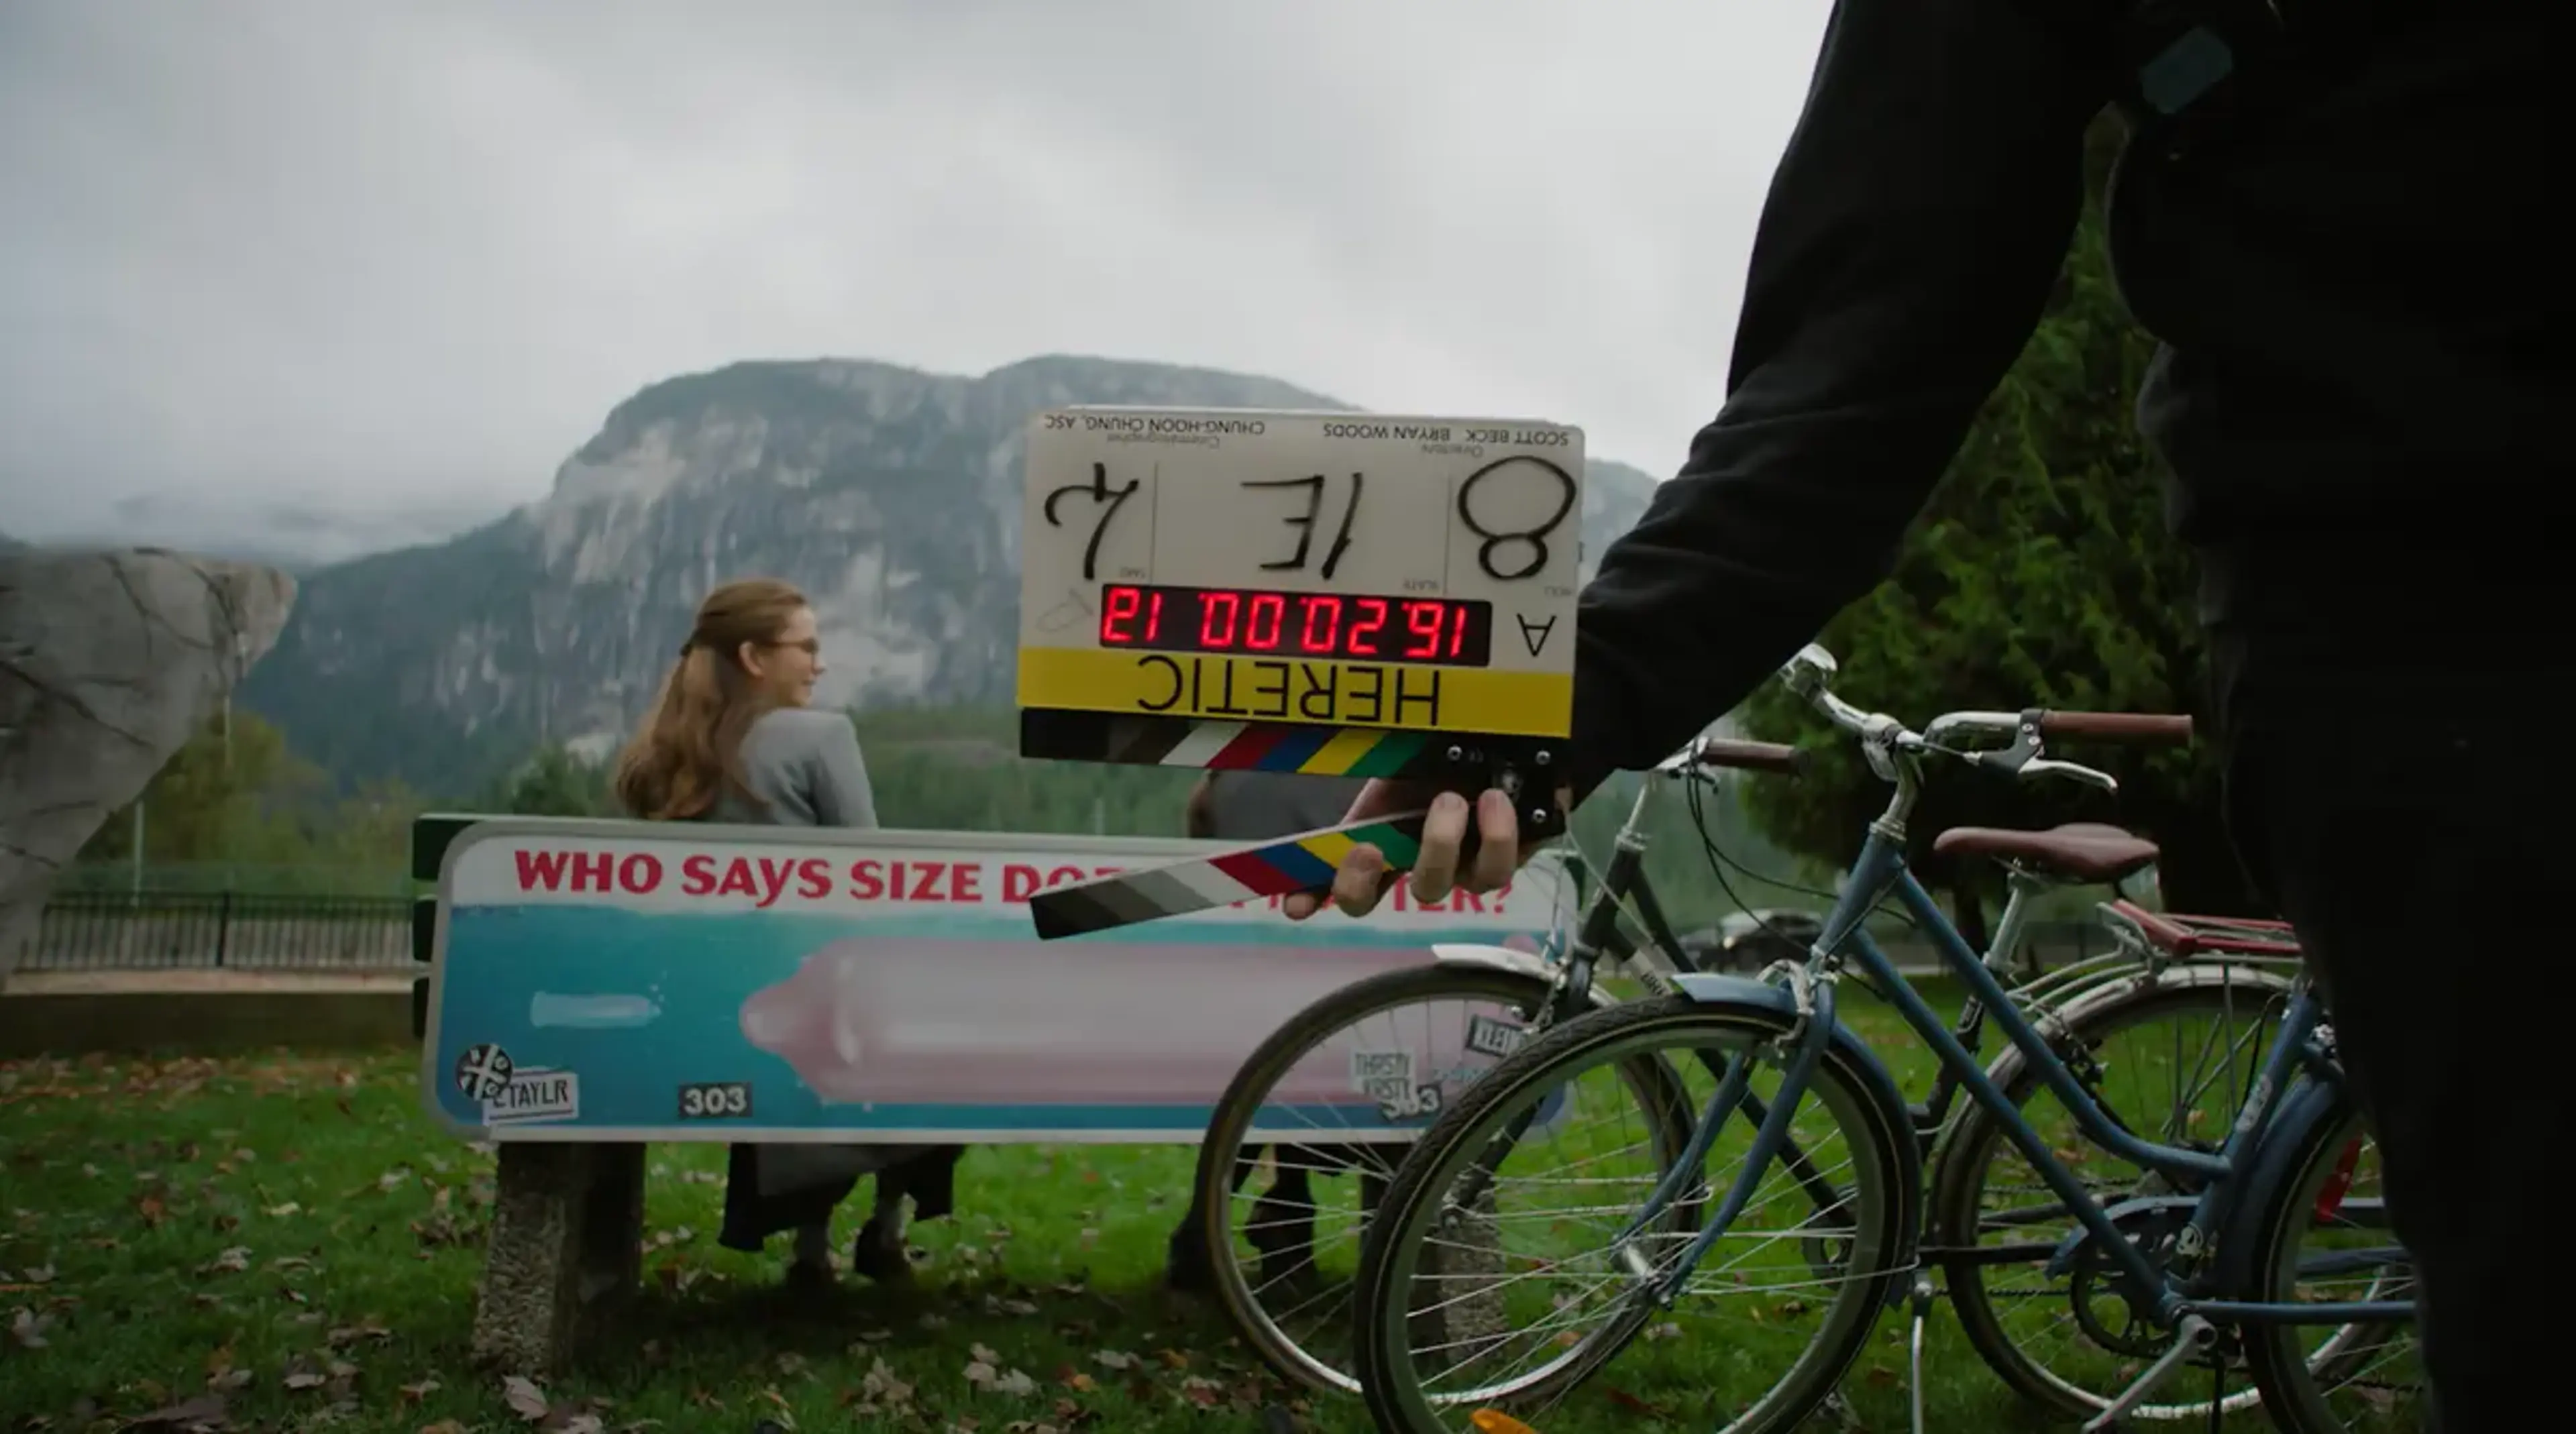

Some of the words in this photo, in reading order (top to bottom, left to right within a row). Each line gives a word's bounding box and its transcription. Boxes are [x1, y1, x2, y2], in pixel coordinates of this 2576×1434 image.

[1044, 414, 1075, 430] ASC
[1149, 418, 1266, 435] CHUNG-HOON
[1323, 423, 1389, 440] WOODS
[1393, 425, 1452, 442] BRYAN
[1465, 428, 1509, 444] BECK
[1514, 430, 1570, 447] SCOTT
[1457, 455, 1577, 581] 8
[1517, 613, 1557, 657] A
[1137, 654, 1440, 726] HERETIC
[515, 851, 663, 894] WHO
[849, 859, 982, 902] SIZE
[684, 1087, 747, 1117] 303
